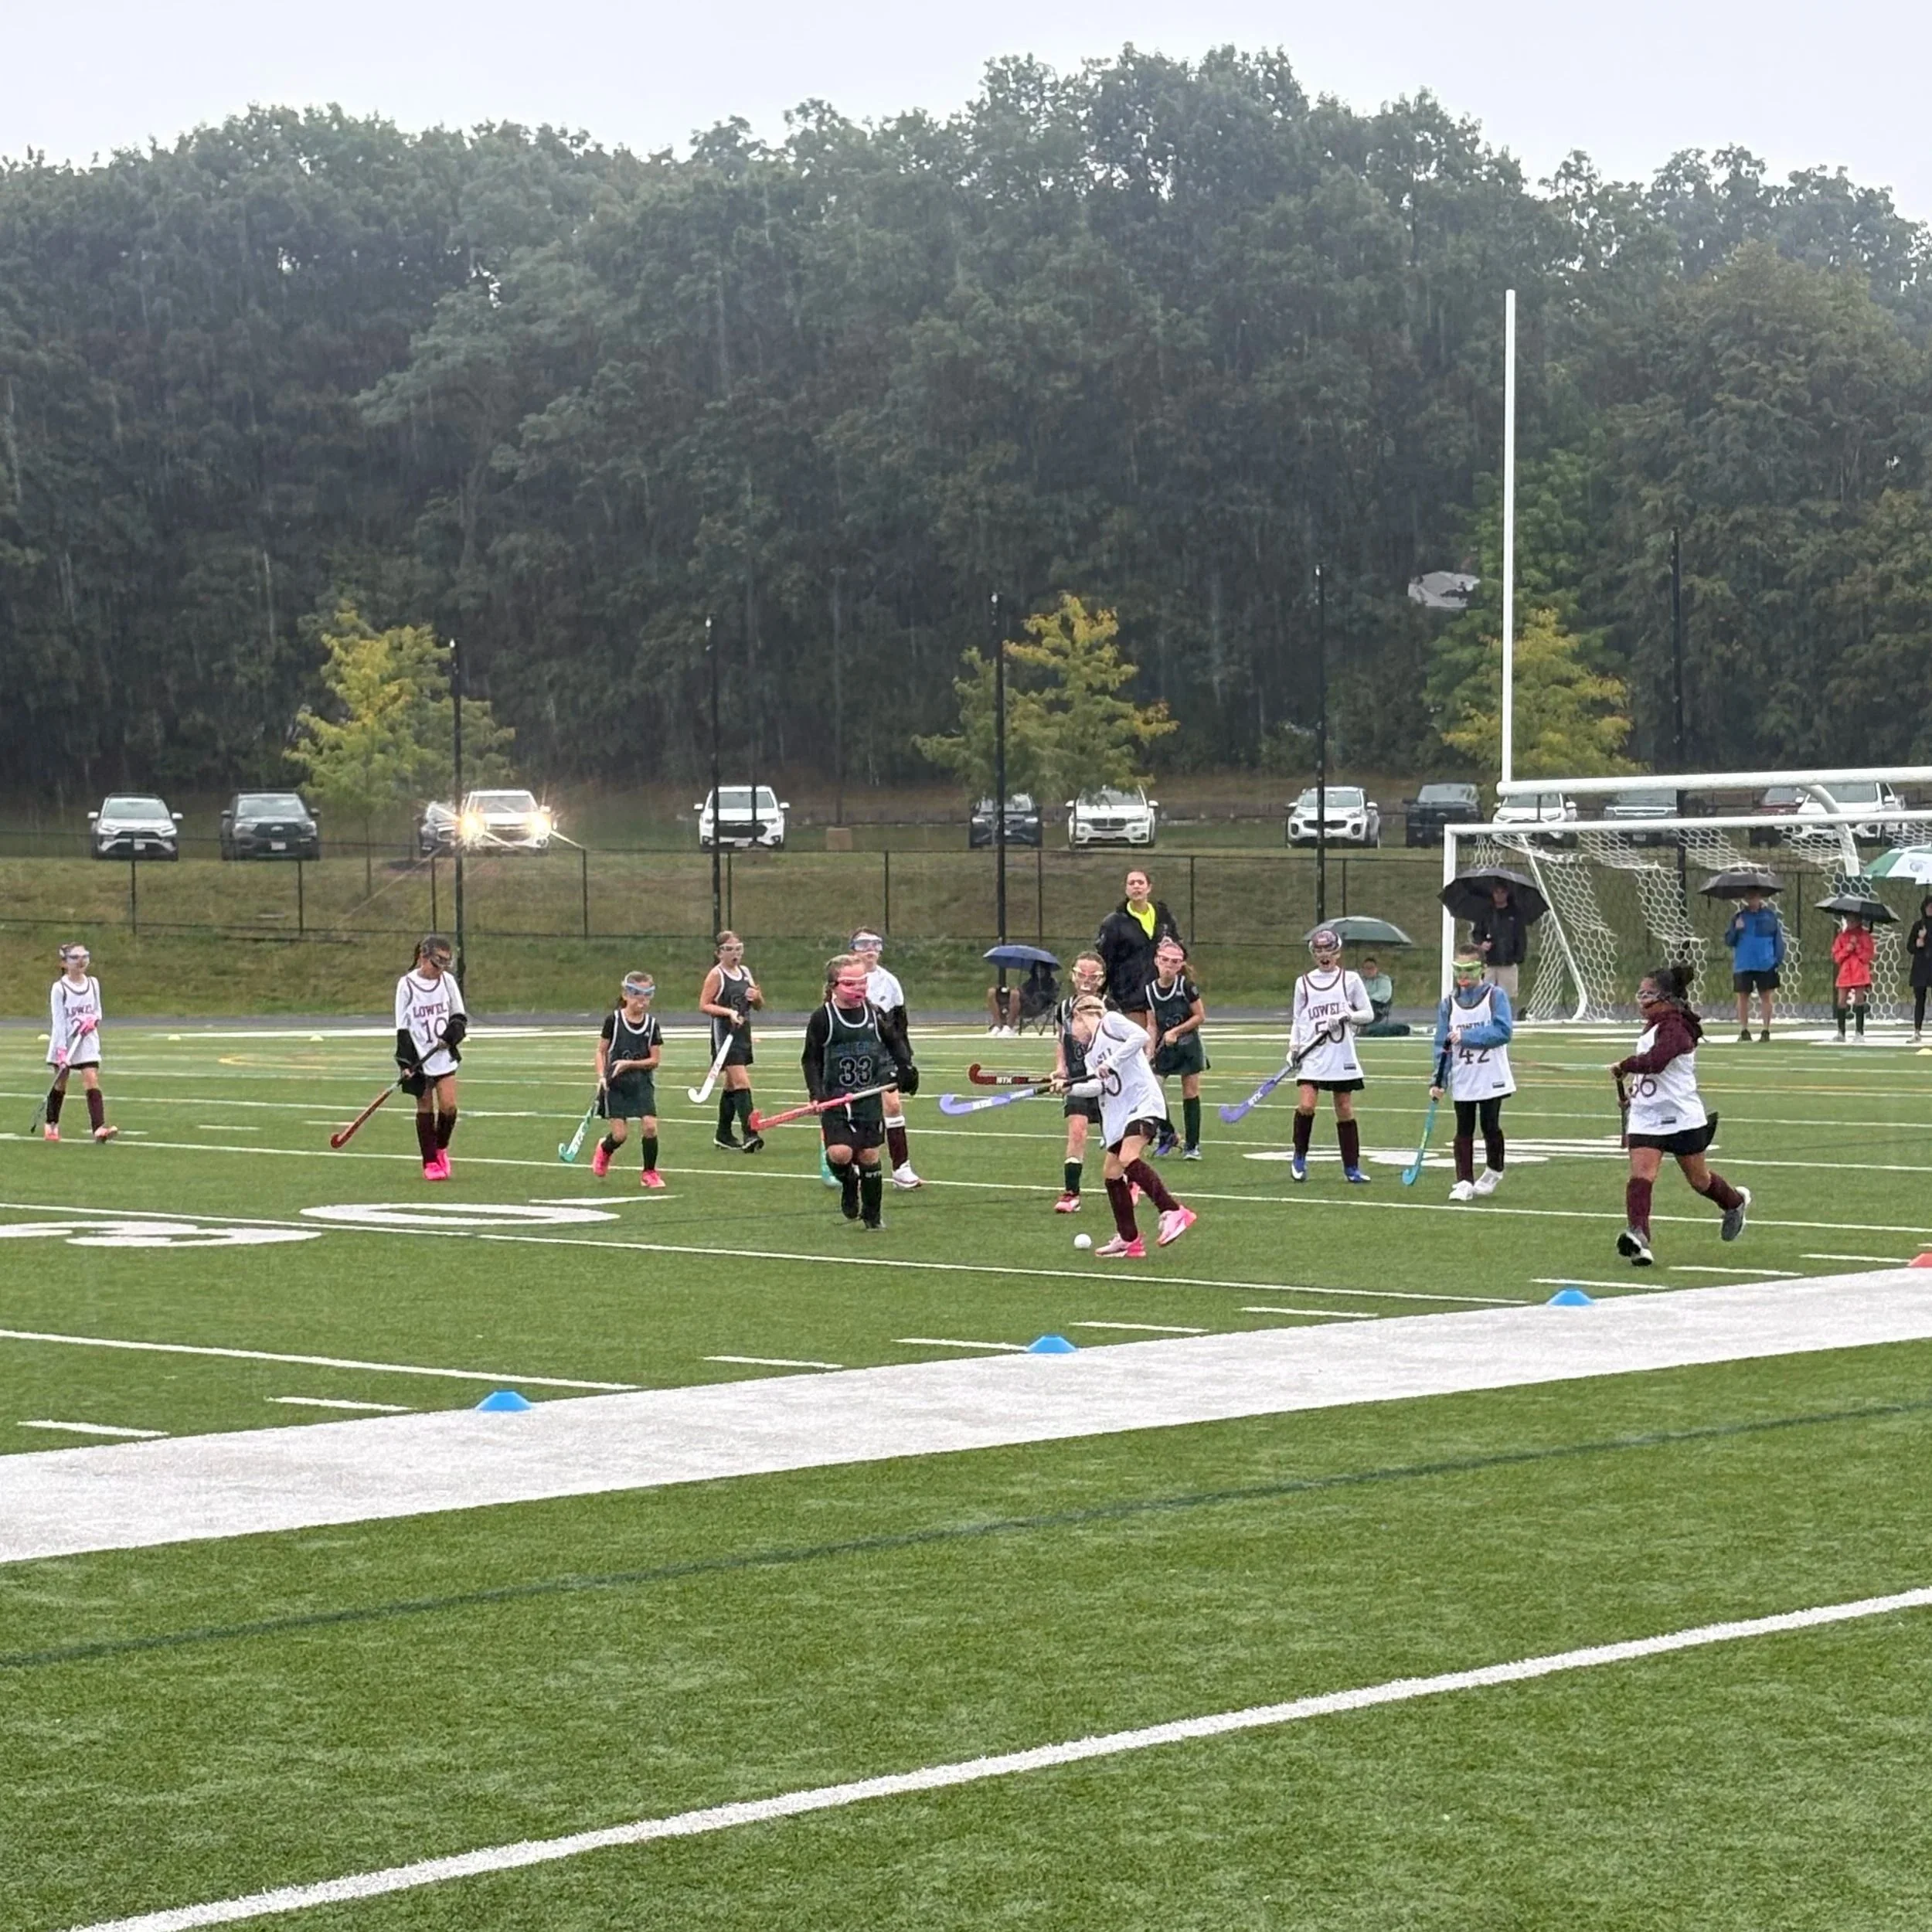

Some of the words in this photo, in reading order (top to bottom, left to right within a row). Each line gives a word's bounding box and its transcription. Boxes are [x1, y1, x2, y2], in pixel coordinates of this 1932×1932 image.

[413, 1002, 450, 1018] LOWEL
[421, 1016, 449, 1043] 10
[839, 1056, 872, 1087] 33
